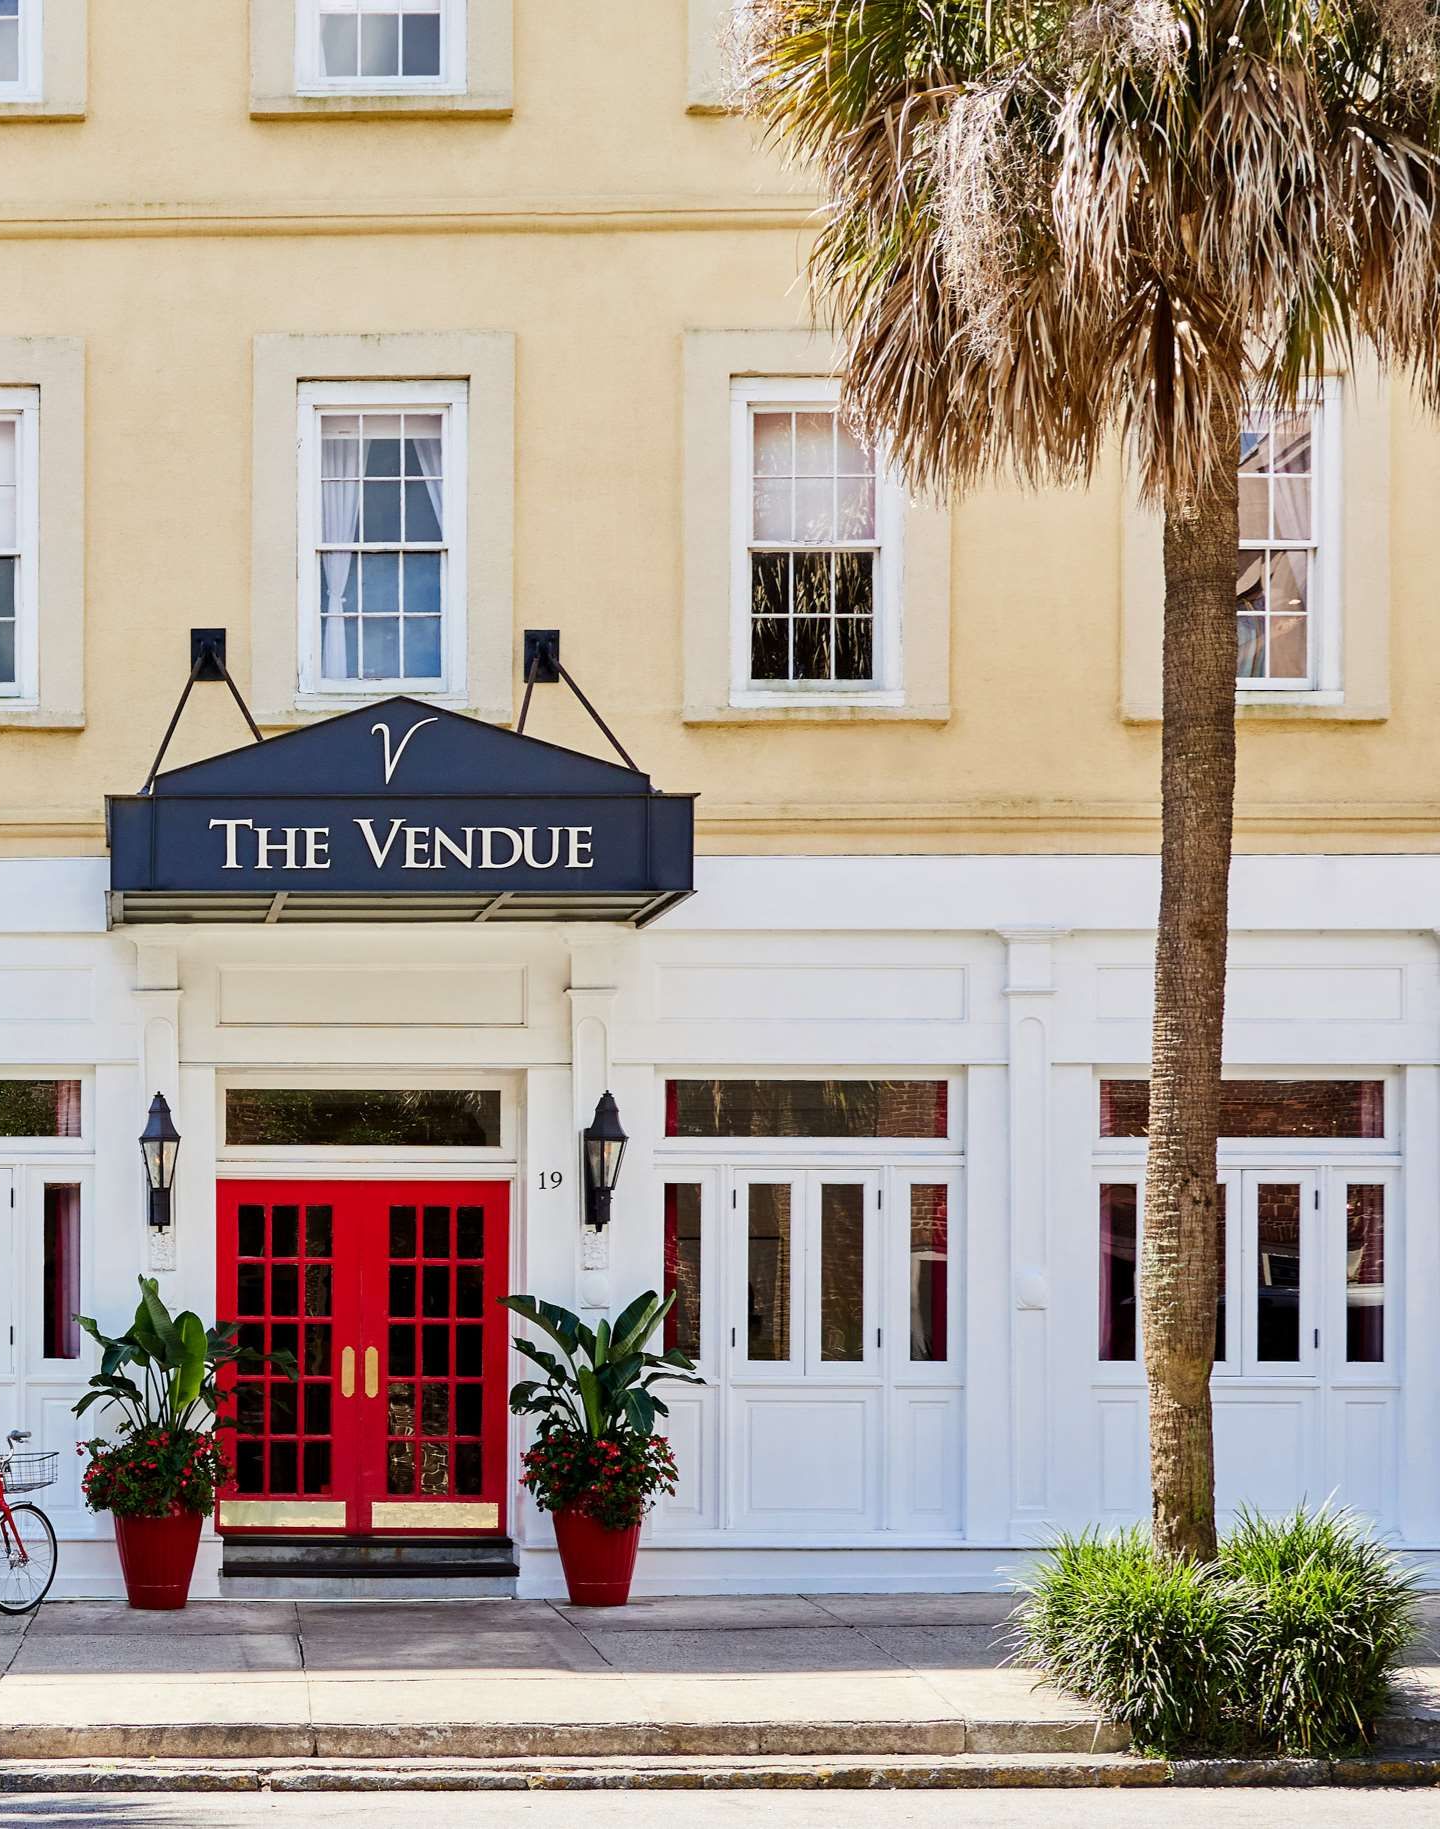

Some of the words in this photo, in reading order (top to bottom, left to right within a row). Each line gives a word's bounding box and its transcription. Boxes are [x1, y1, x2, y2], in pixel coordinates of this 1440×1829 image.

[371, 717, 438, 785] V
[208, 818, 331, 869] THE
[352, 818, 594, 869] VENDUE
[538, 1171, 563, 1190] 19
